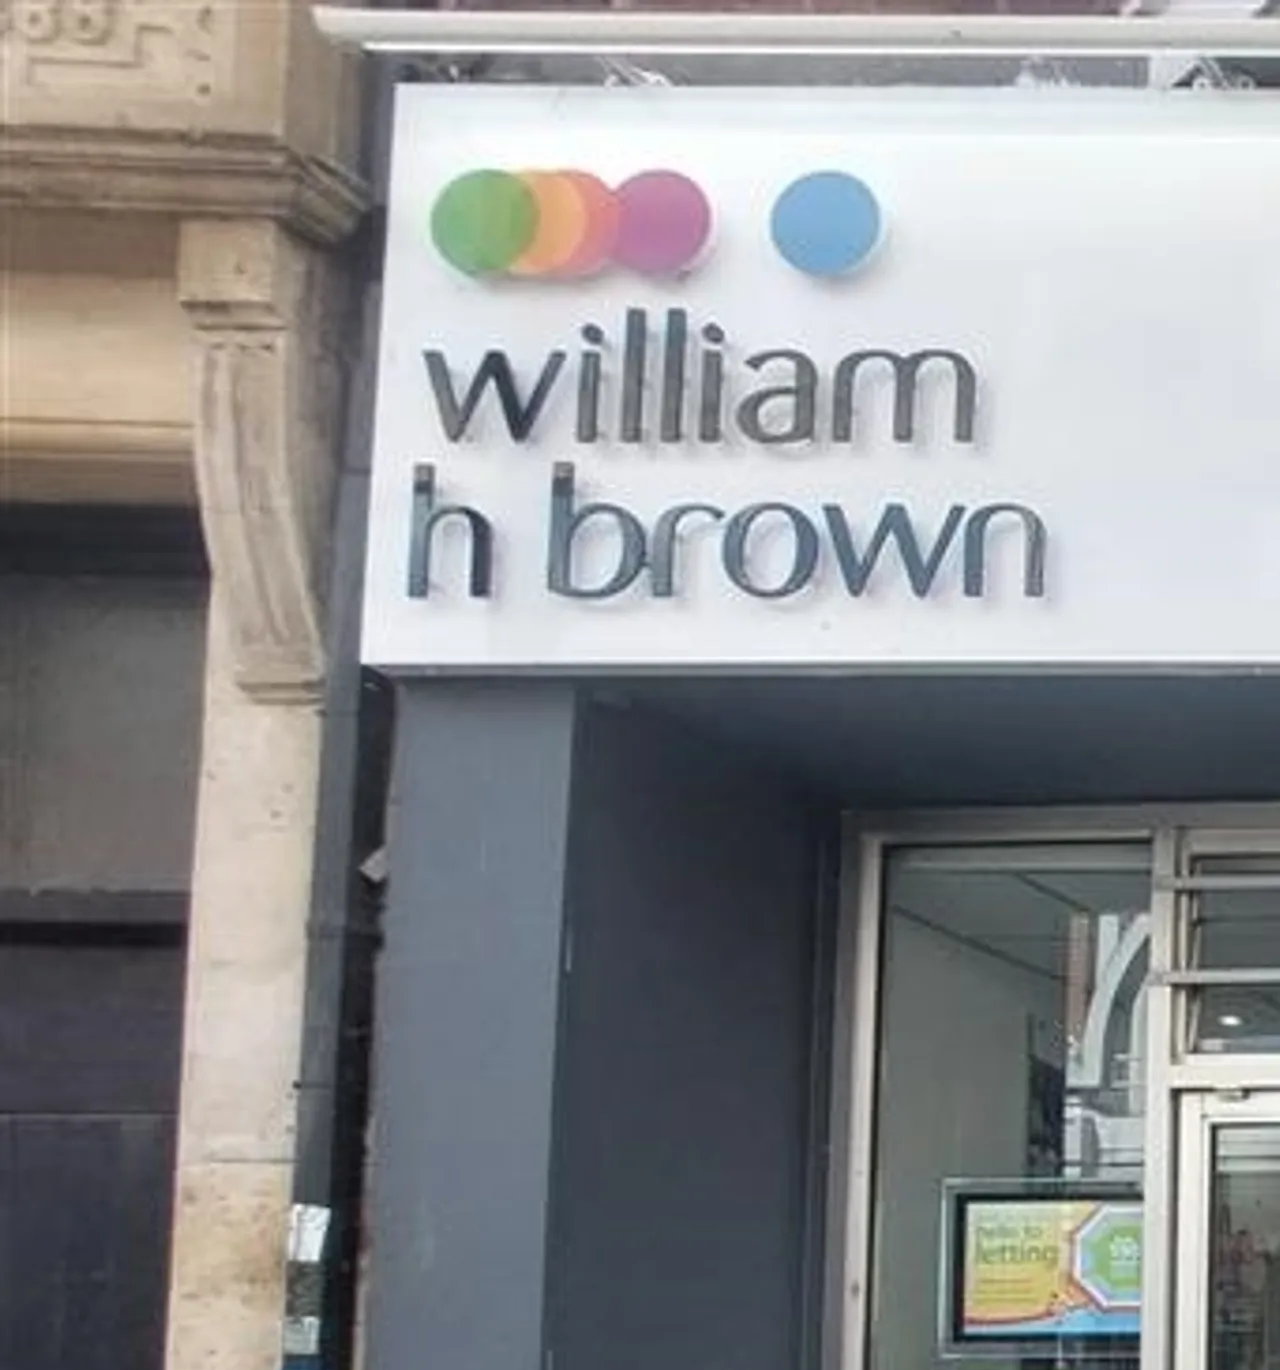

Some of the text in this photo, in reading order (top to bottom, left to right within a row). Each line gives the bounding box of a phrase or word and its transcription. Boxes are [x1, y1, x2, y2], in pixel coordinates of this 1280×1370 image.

[423, 308, 978, 443] william
[406, 460, 1048, 600] h brown
[975, 1240, 1059, 1271] letting
